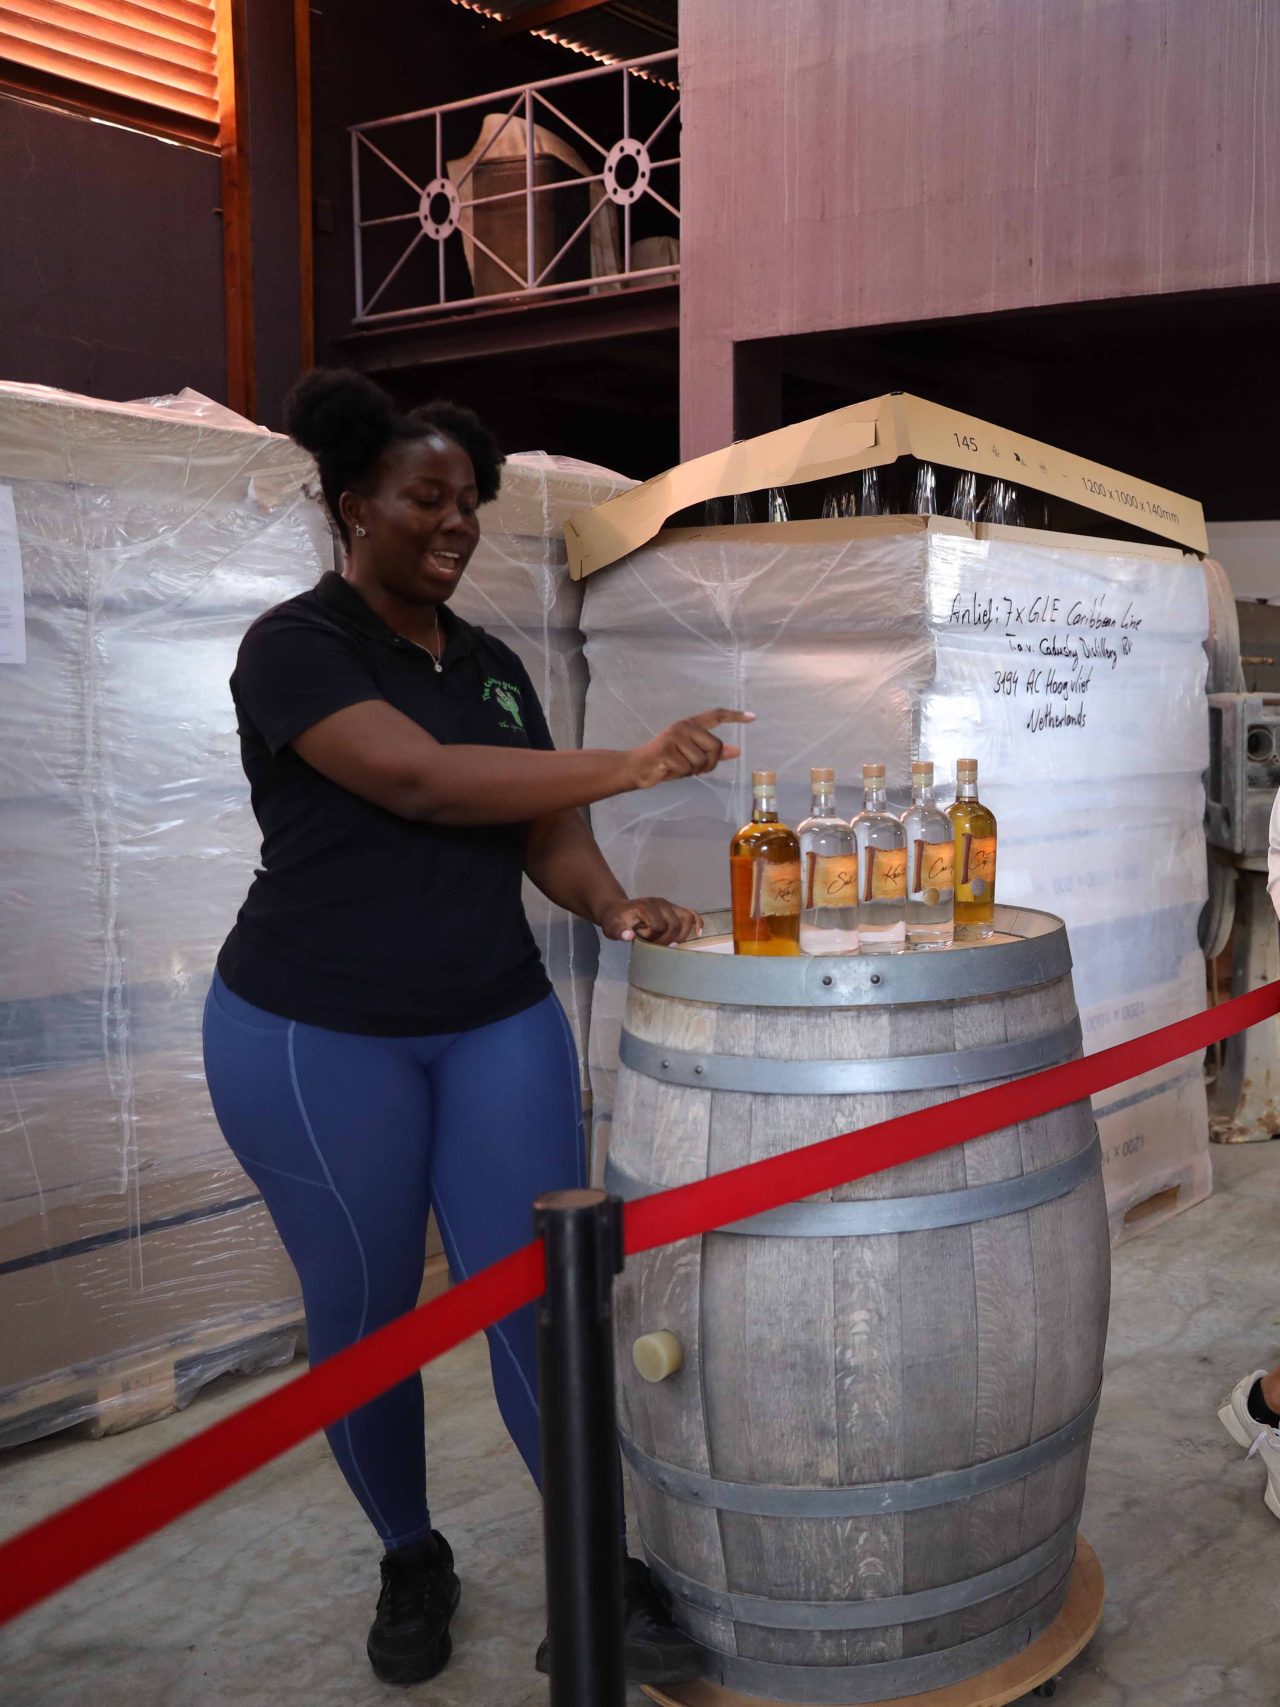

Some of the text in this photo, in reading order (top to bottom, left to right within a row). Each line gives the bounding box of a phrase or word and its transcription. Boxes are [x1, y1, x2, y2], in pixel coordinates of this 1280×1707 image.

[954, 433, 978, 452] 145
[1081, 477, 1106, 497] 1200
[1108, 489, 1114, 500] x
[1115, 489, 1138, 509] 1000
[1146, 501, 1180, 525] 140mm
[1067, 593, 1116, 629] Caribbean
[993, 670, 1019, 697] 3194
[1026, 668, 1042, 695] AC
[1026, 701, 1086, 733] Netherlands
